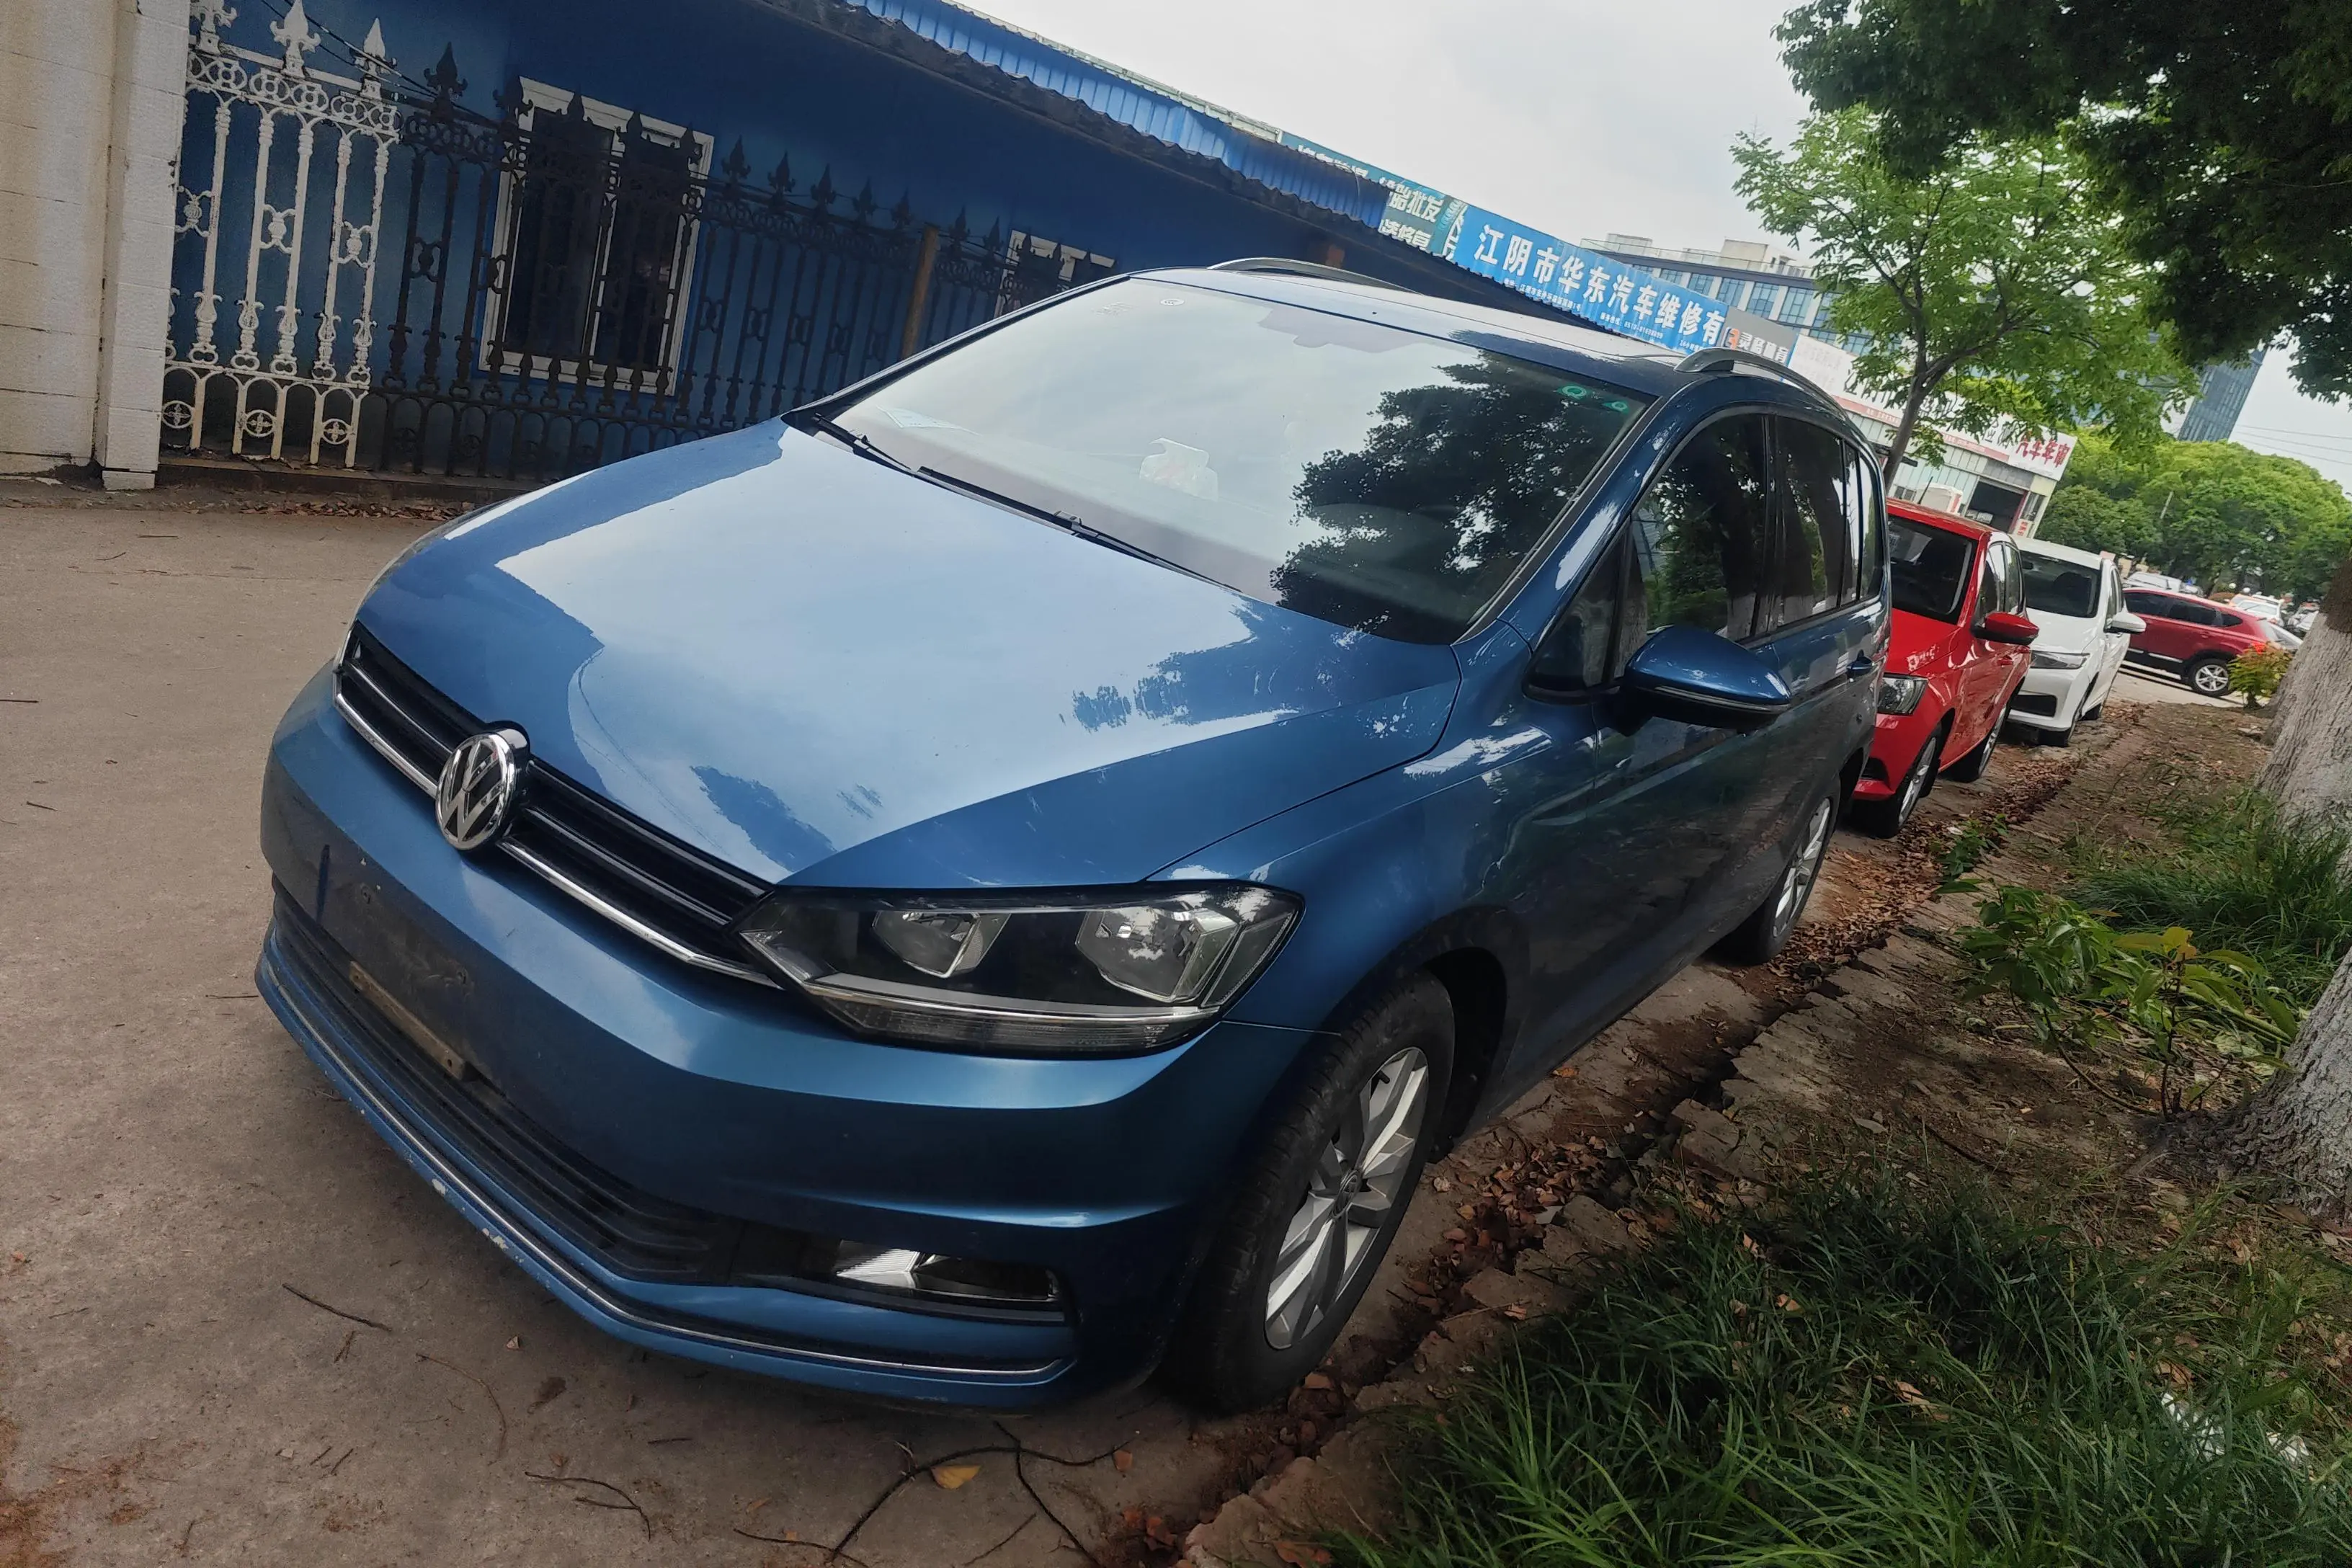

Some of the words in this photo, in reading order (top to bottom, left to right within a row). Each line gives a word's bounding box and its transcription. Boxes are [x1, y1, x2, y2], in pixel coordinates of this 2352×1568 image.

[1474, 224, 1725, 345] 江阴市华东汽车维修有
